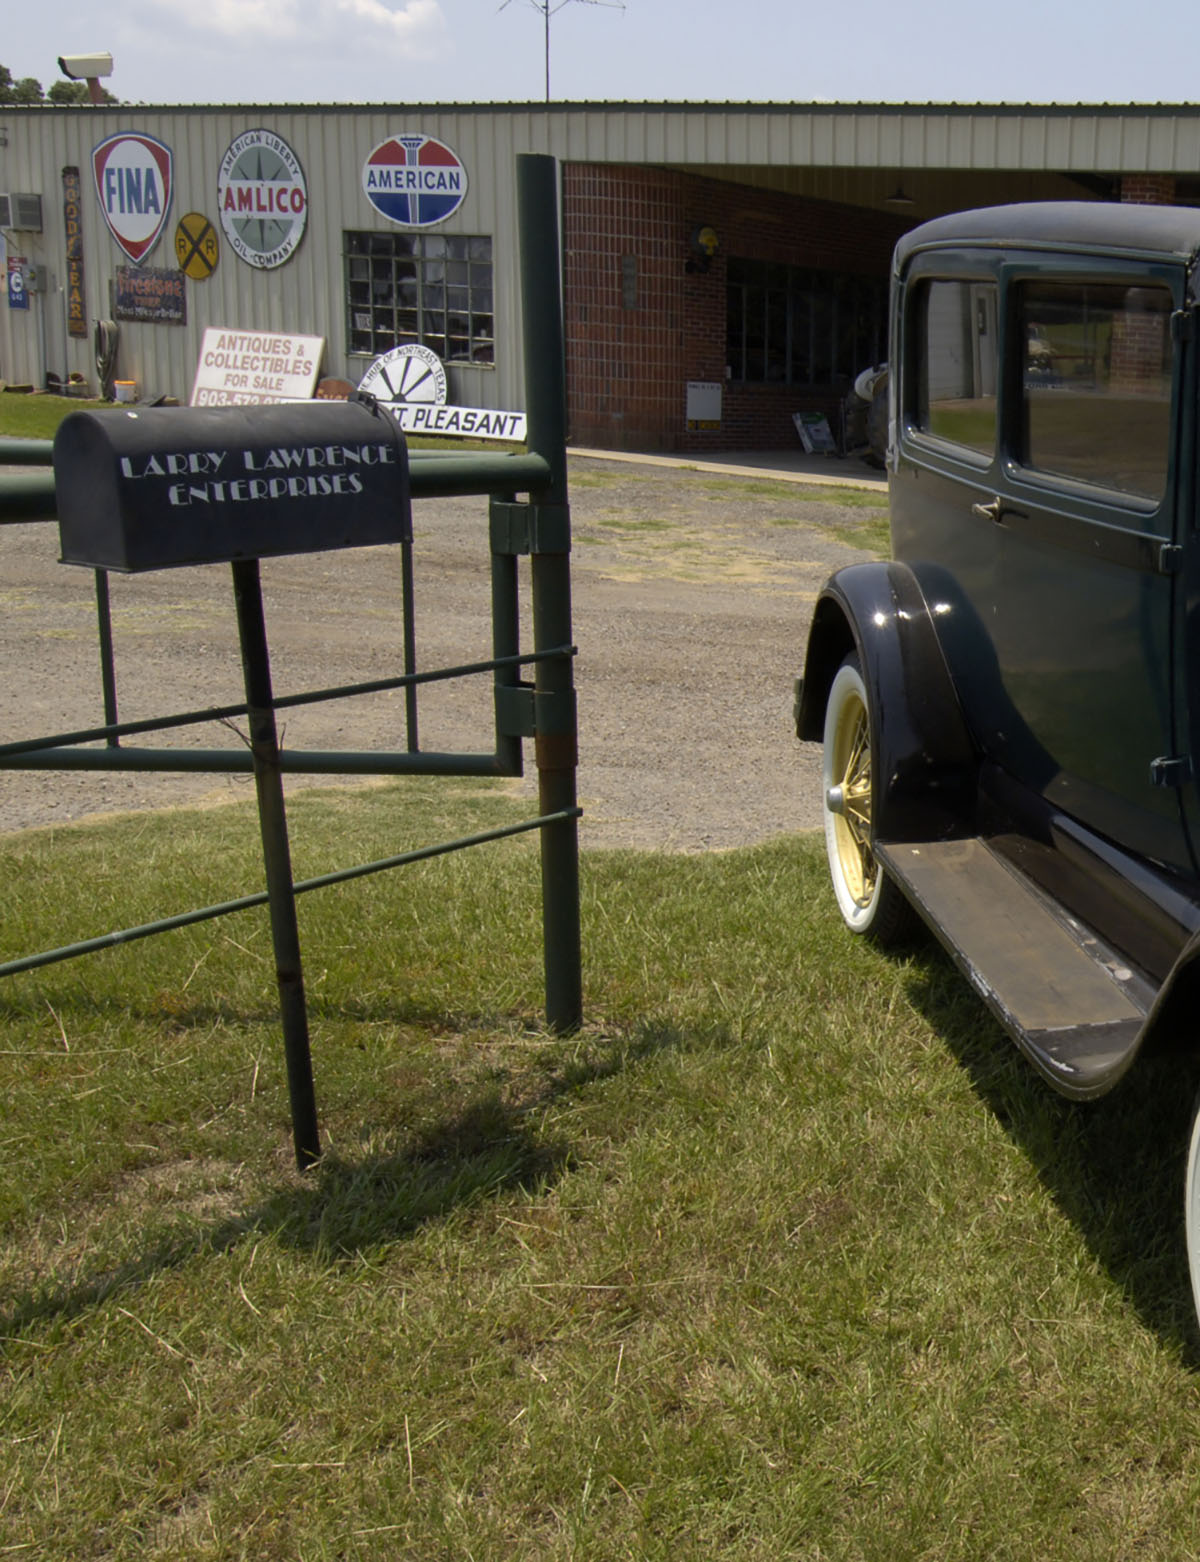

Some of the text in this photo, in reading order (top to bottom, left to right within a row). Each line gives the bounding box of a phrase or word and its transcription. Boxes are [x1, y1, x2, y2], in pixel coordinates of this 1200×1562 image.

[223, 133, 299, 175] AMERICAN LIBERTY
[105, 167, 161, 214] FINA
[367, 169, 460, 190] AMERICAN
[224, 186, 304, 214] AMLICO
[178, 238, 216, 255] R R
[233, 238, 294, 265] OIL COMPANY
[216, 334, 305, 357] ANTIQUES &
[204, 351, 313, 377] COLLECTIBLES
[367, 346, 446, 402] HUB OF NORTHEAST TEXAS
[223, 373, 285, 391] FOR SALE
[412, 408, 523, 436] PLEASANT
[120, 444, 396, 478] LARRY LAWRENCE
[168, 472, 364, 506] ENTERPRISES
